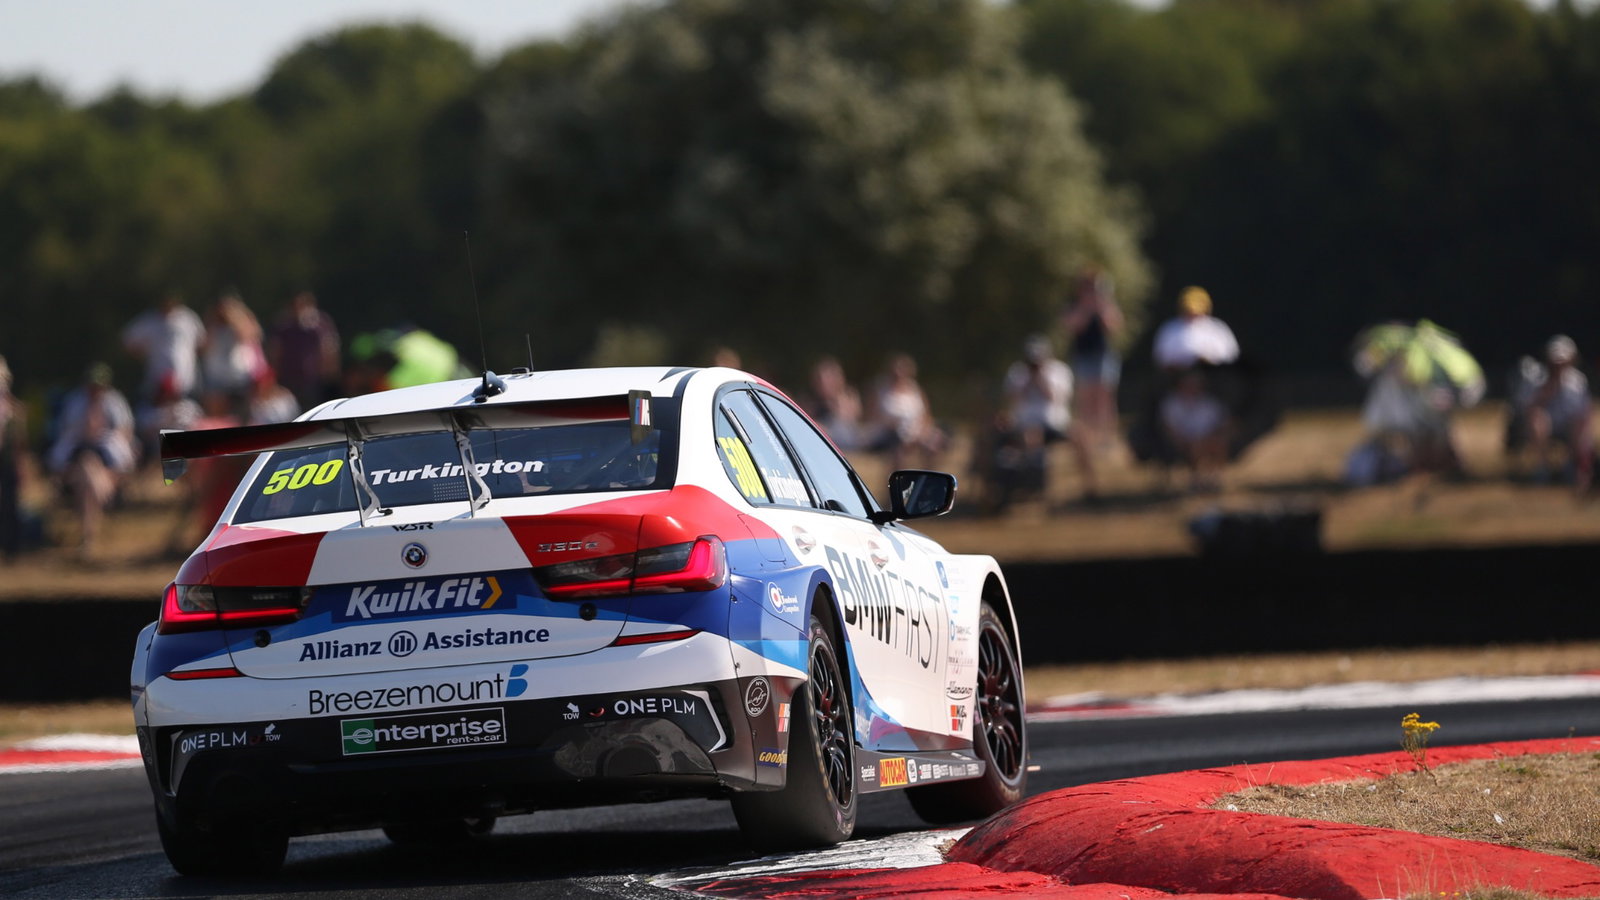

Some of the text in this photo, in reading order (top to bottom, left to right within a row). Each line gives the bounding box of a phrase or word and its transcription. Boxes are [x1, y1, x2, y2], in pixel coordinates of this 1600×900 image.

[262, 459, 545, 495] 500 Turkington
[392, 521, 434, 532] WSR
[299, 627, 550, 663] Allianz Assistance
[309, 673, 504, 715] Breezemount
[562, 712, 580, 721] TOW
[614, 698, 696, 716] ONE PLM
[265, 734, 281, 742] TOW
[351, 717, 501, 744] enterprise
[447, 733, 502, 744] rent-a-car
[180, 730, 247, 754] ONE PLM
